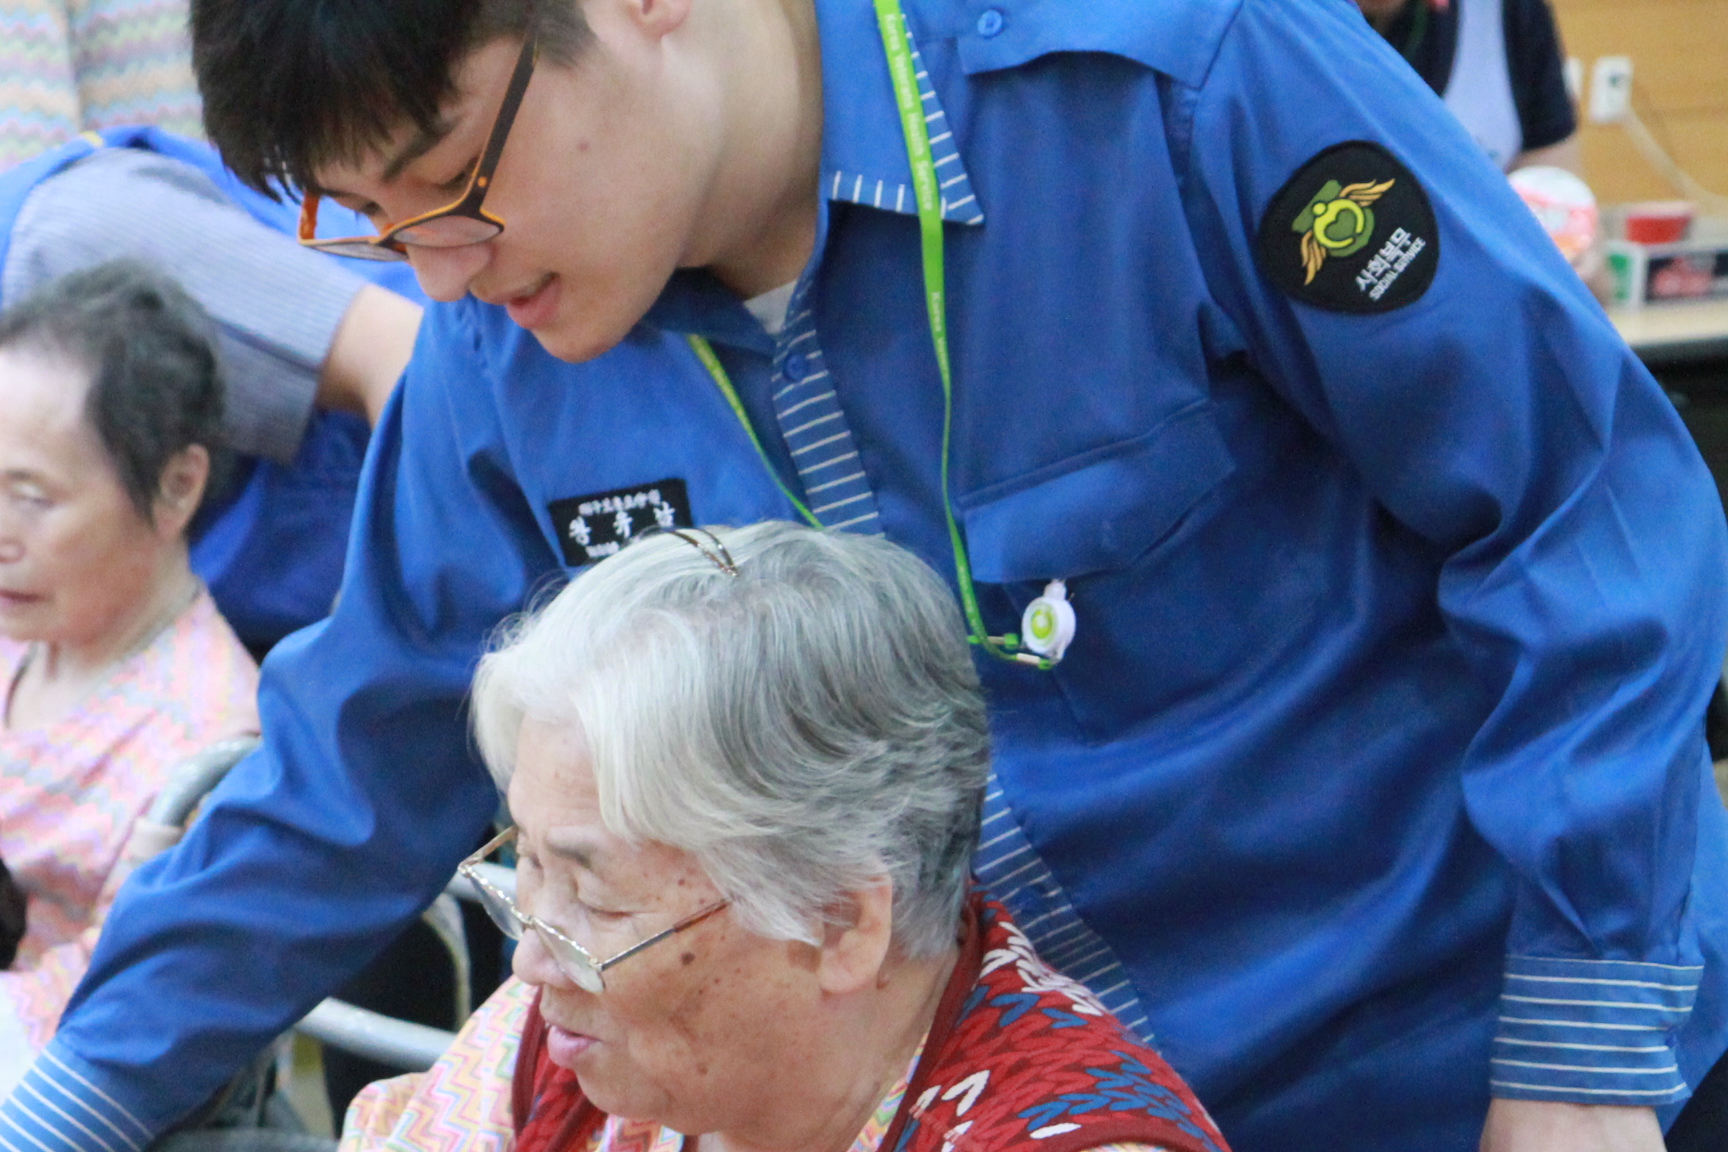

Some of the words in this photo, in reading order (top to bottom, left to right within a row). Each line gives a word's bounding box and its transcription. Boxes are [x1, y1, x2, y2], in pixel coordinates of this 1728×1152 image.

[1355, 227, 1411, 292] 사회복무
[1369, 267, 1398, 300] SOCIAL
[1392, 237, 1426, 273] SERVICE
